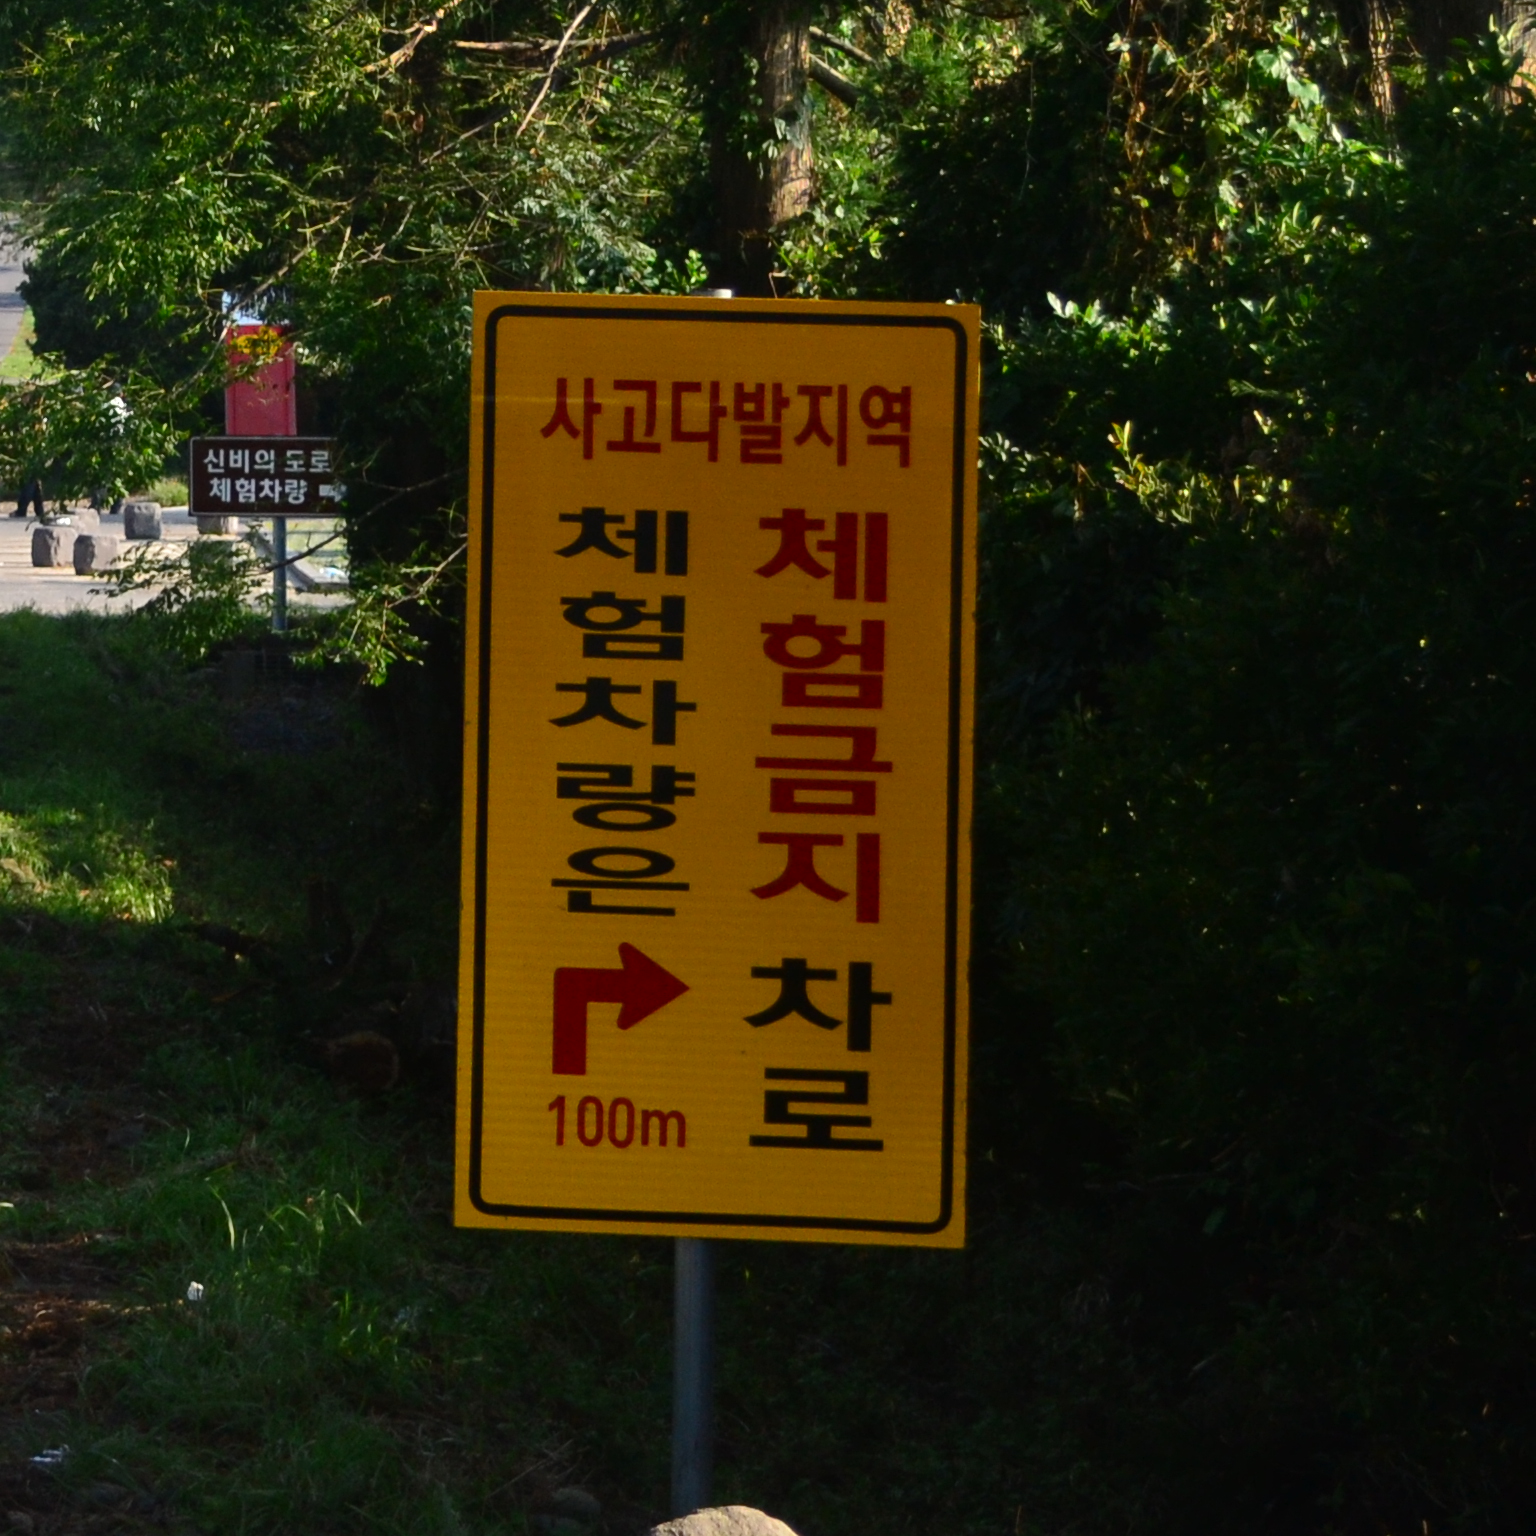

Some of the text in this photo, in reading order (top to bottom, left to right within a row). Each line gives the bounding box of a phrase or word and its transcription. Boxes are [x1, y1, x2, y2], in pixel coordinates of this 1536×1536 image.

[540, 376, 915, 468] 사고다발지역
[203, 449, 332, 474] 신비의 도로
[208, 477, 308, 505] 체험차량
[549, 505, 697, 917] 체험차량은
[743, 507, 893, 1153] 체험금지 차로
[546, 1095, 687, 1150] 100m
